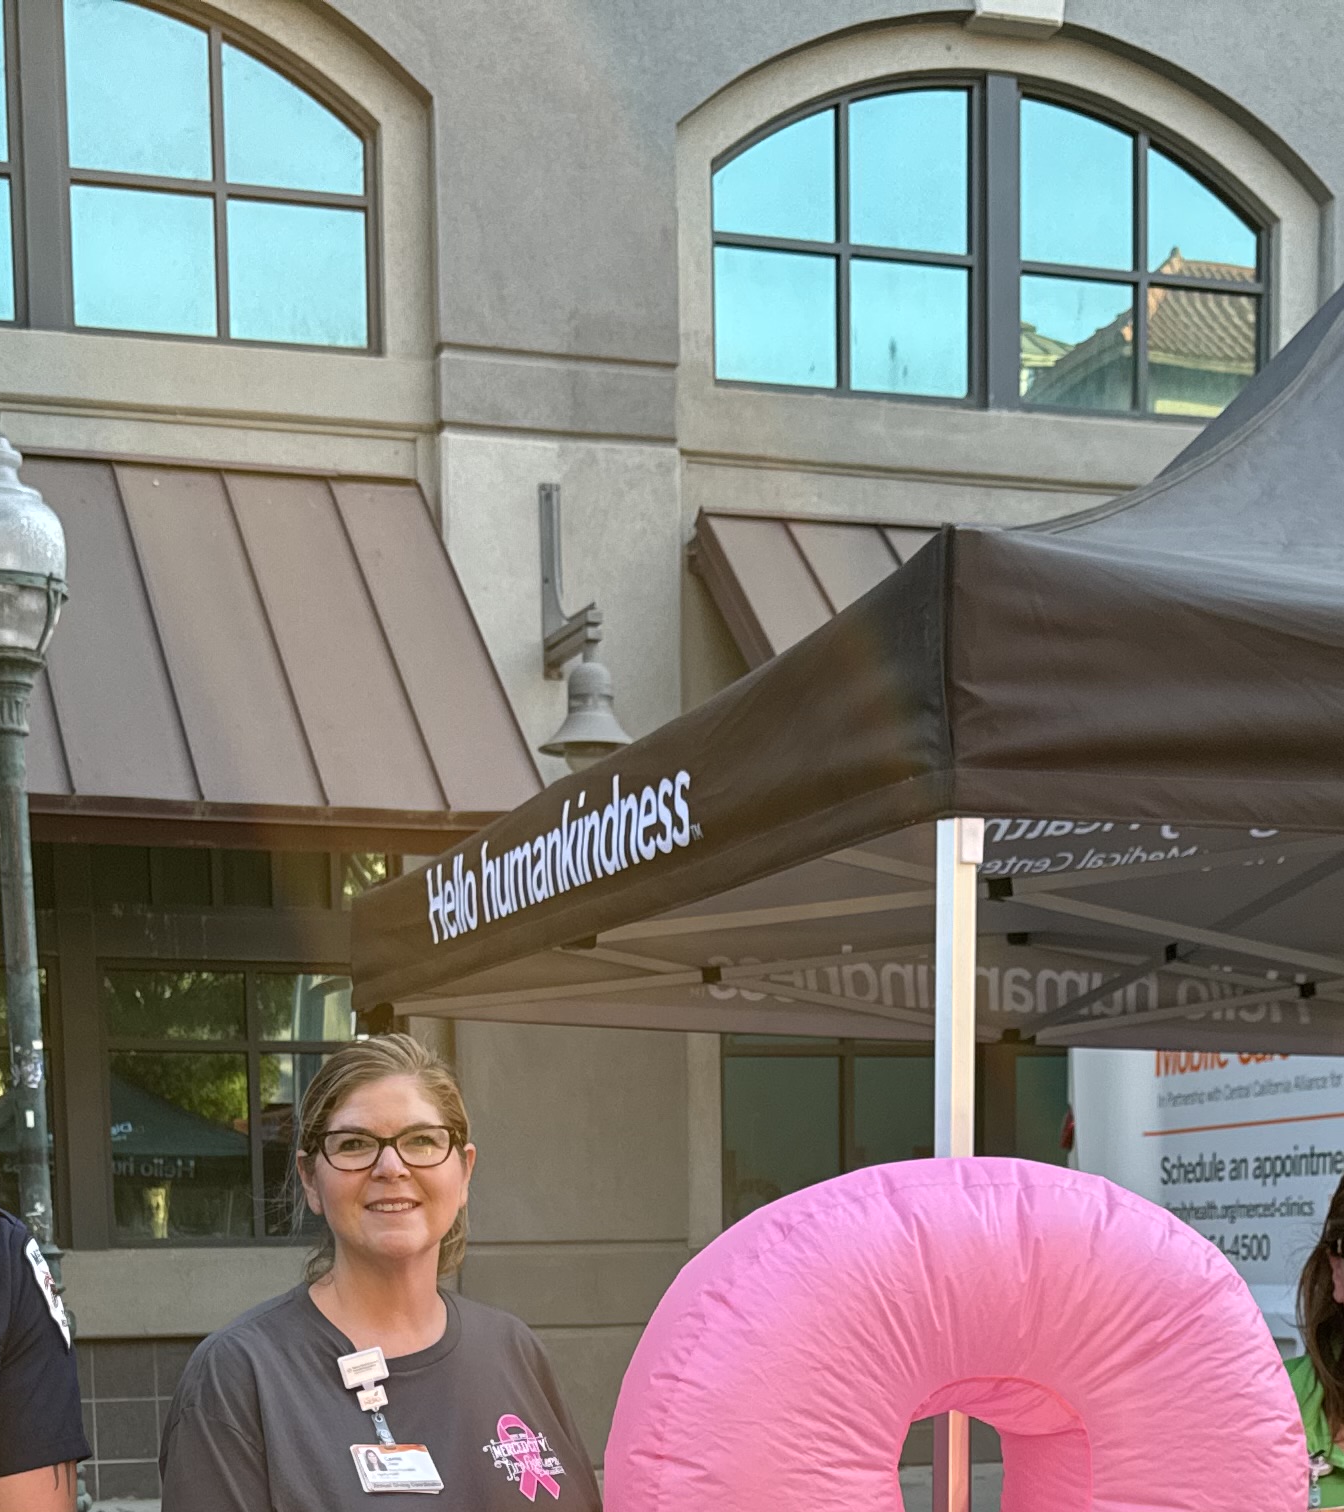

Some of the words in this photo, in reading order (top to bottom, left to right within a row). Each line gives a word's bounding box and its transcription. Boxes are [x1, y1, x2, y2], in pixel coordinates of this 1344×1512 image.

[426, 853, 478, 945] Hello
[481, 769, 691, 923] humankindness
[1160, 1152, 1225, 1186] Schedule
[1228, 1158, 1249, 1182] an
